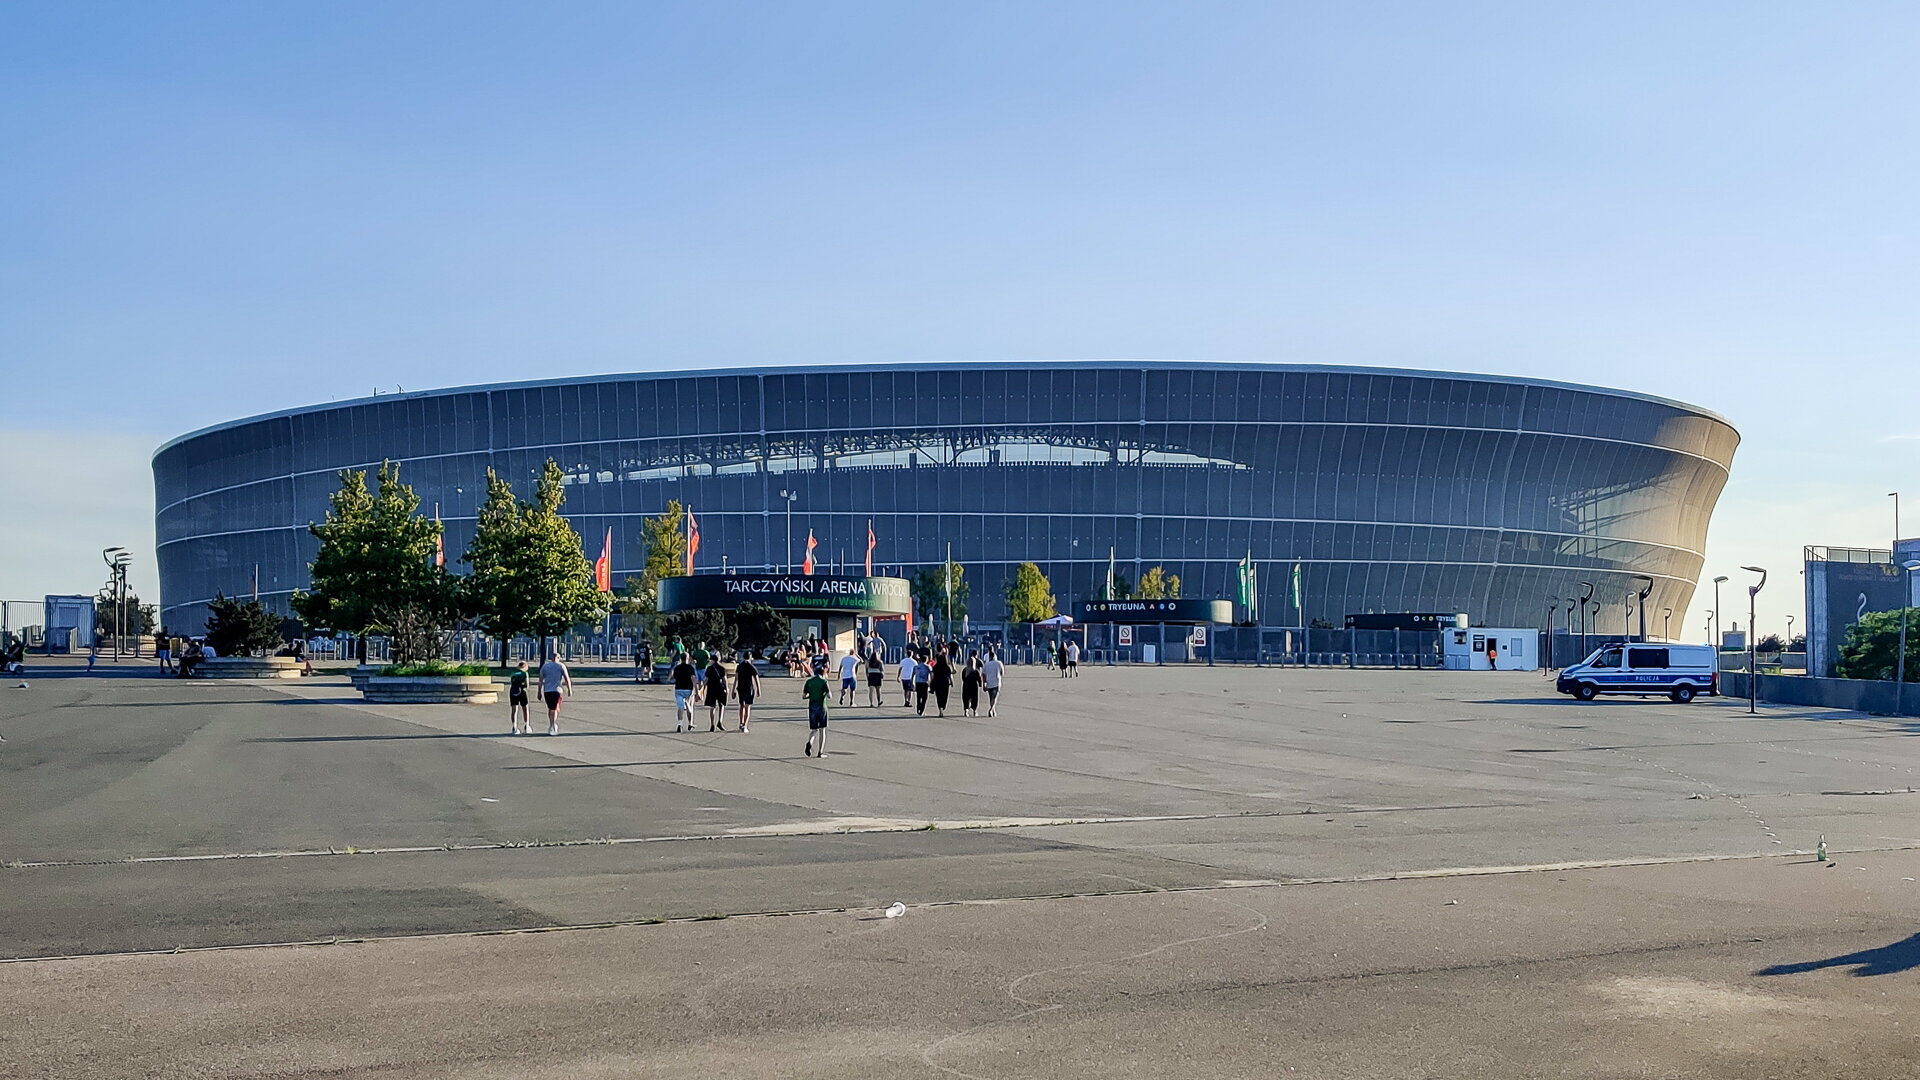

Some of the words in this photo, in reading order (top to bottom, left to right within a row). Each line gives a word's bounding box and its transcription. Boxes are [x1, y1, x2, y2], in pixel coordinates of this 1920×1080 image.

[724, 576, 814, 593] TARCZYŃSKI
[820, 580, 867, 594] ARENA
[786, 595, 829, 608] Witamy
